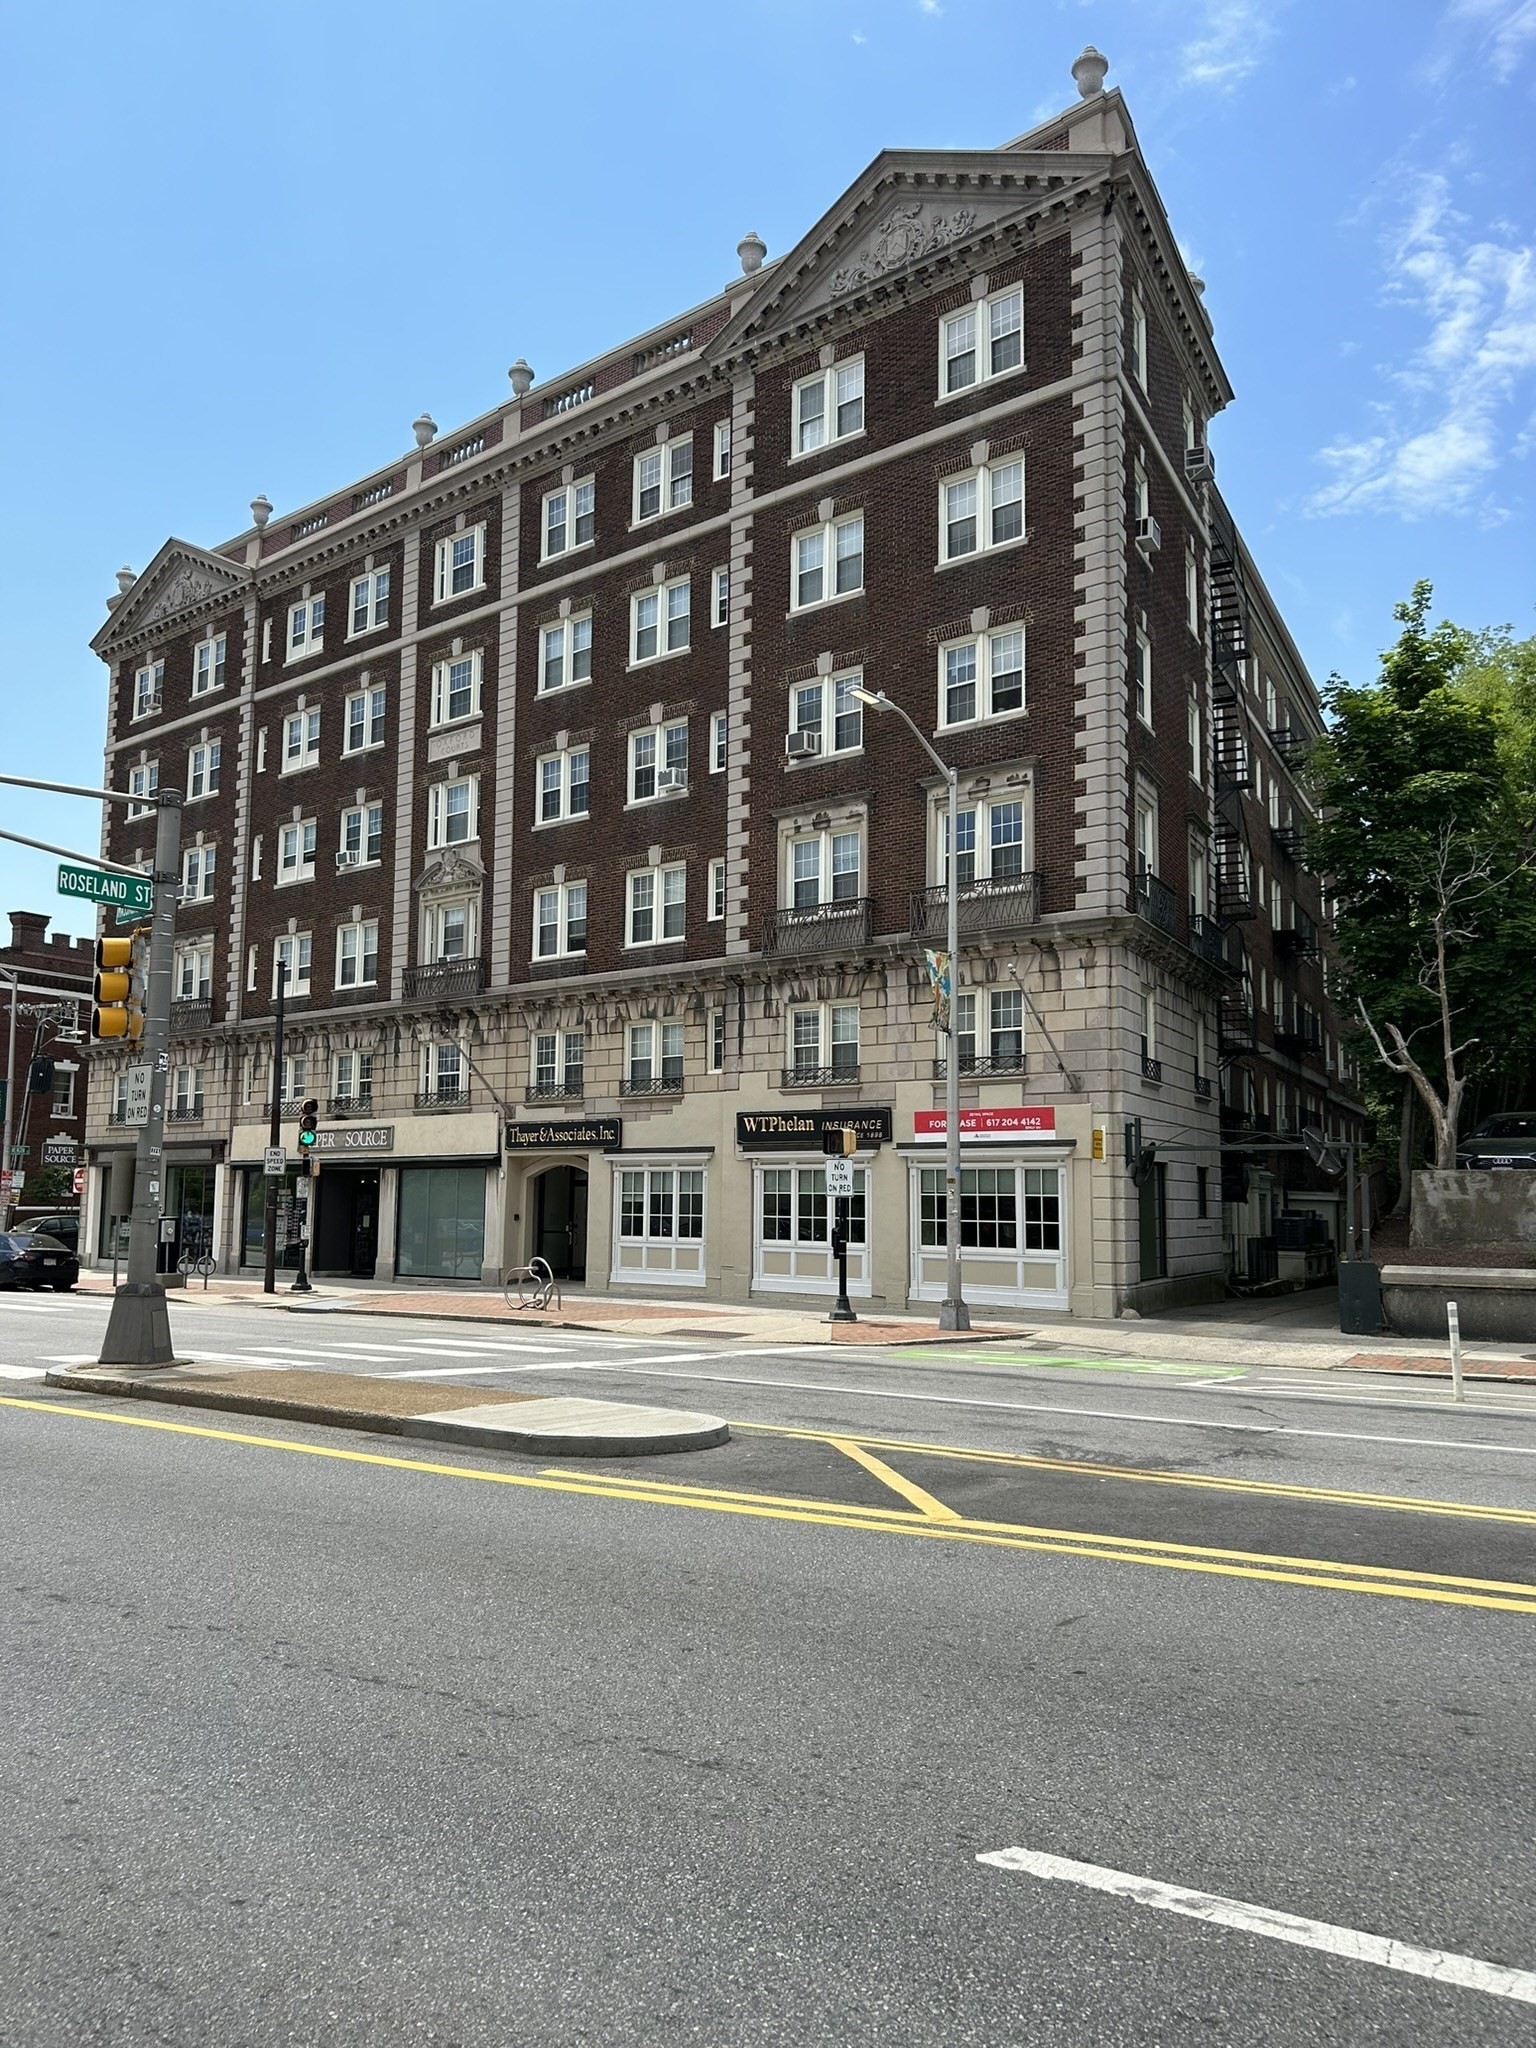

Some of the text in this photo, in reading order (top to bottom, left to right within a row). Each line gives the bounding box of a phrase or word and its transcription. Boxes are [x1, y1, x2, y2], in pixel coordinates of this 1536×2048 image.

[437, 731, 474, 748] OXFORD
[441, 742, 469, 755] COURTS
[60, 871, 151, 903] ROSELAND ST
[134, 1072, 145, 1084] NO
[131, 1089, 147, 1102] TURN
[127, 1107, 136, 1119] ON
[136, 1106, 147, 1118] RED
[821, 1119, 883, 1131] INSURANCE
[929, 1120, 946, 1129] FOR
[986, 1118, 1000, 1127] 617
[1001, 1118, 1019, 1126] 204
[1020, 1117, 1041, 1126] 4142
[345, 1130, 388, 1147] SOURCE
[599, 1125, 616, 1140] Inc.
[48, 1146, 74, 1155] PAPER
[44, 1155, 77, 1163] SOURCE
[833, 1163, 845, 1171] NO
[828, 1184, 852, 1193] ON RED
